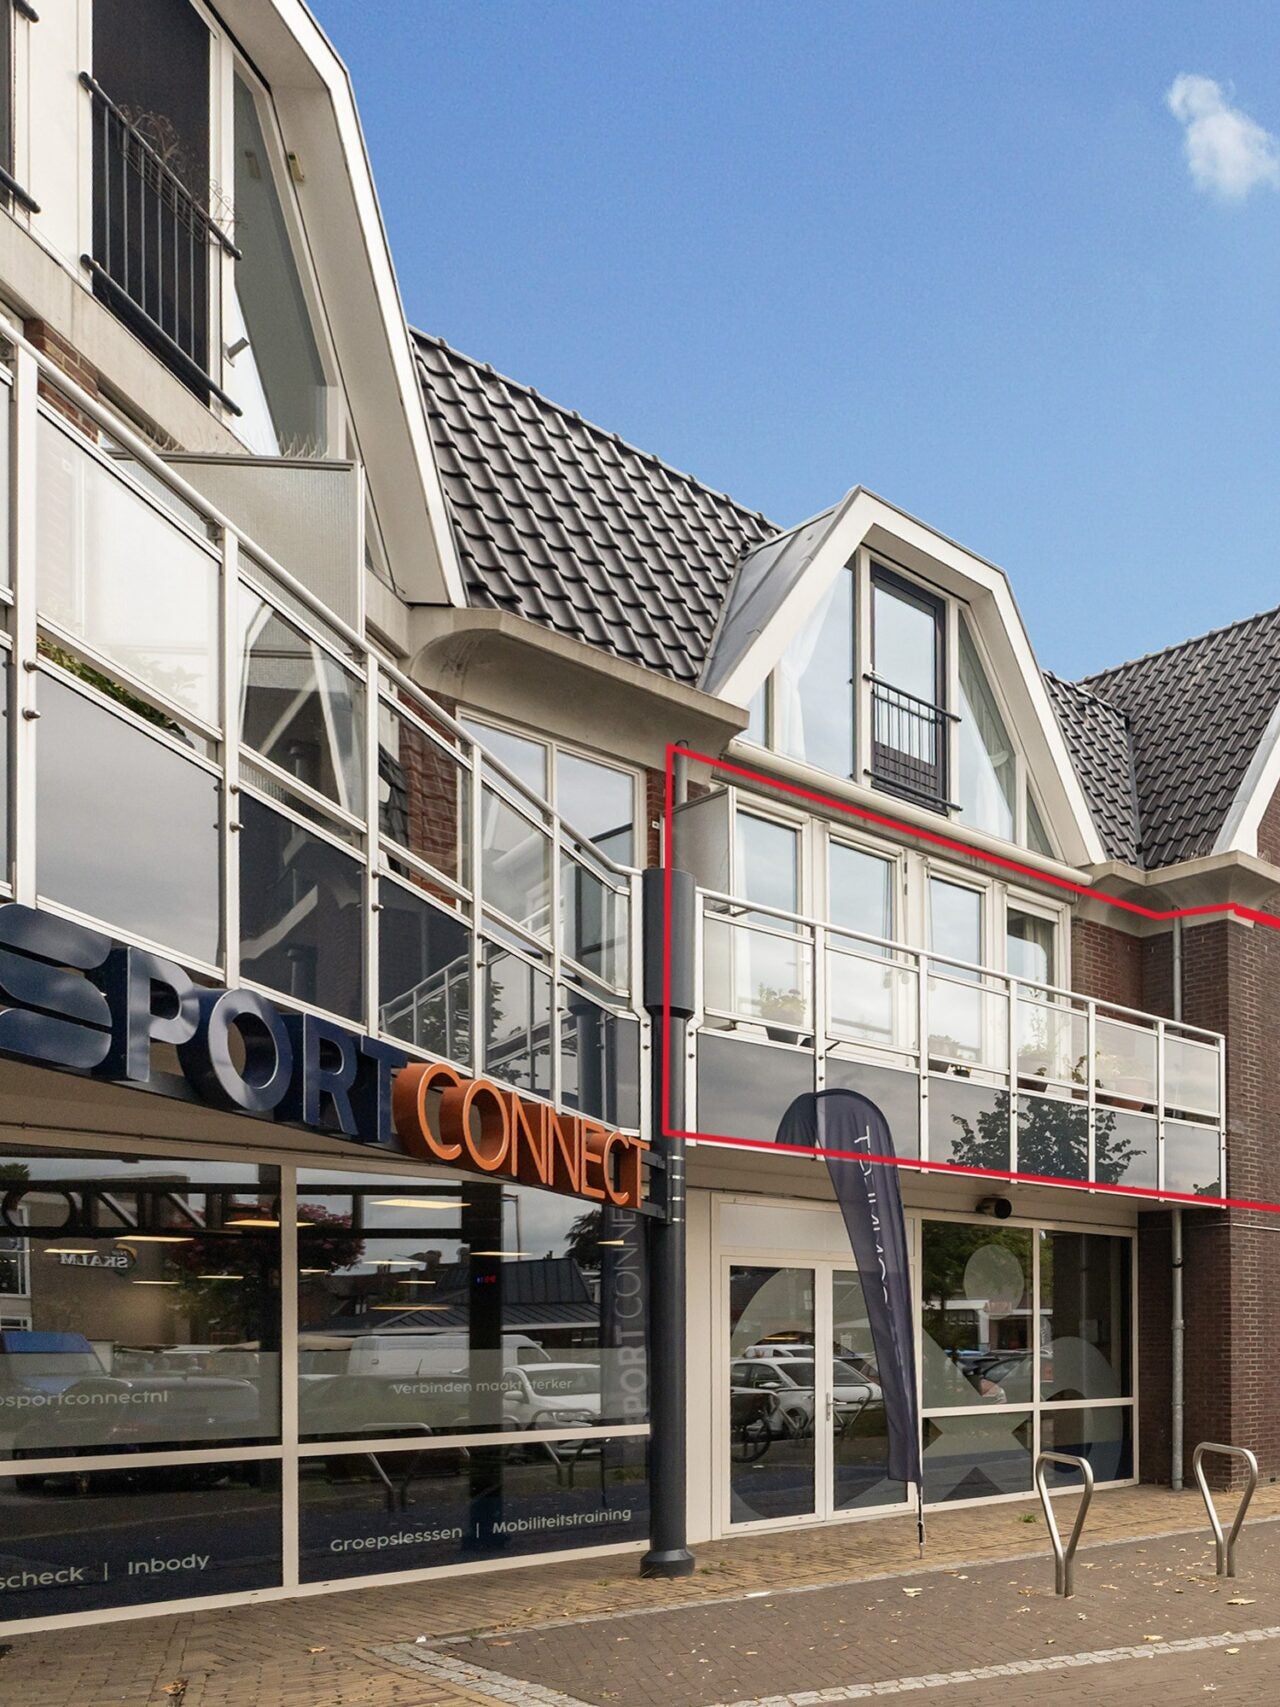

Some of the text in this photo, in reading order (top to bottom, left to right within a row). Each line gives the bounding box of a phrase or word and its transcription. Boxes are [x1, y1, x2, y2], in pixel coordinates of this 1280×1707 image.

[393, 1382, 472, 1395] Verbinden
[476, 1380, 523, 1392] maakt
[492, 1507, 632, 1534] Mobiliteitstraining
[128, 1553, 210, 1575] Inbody
